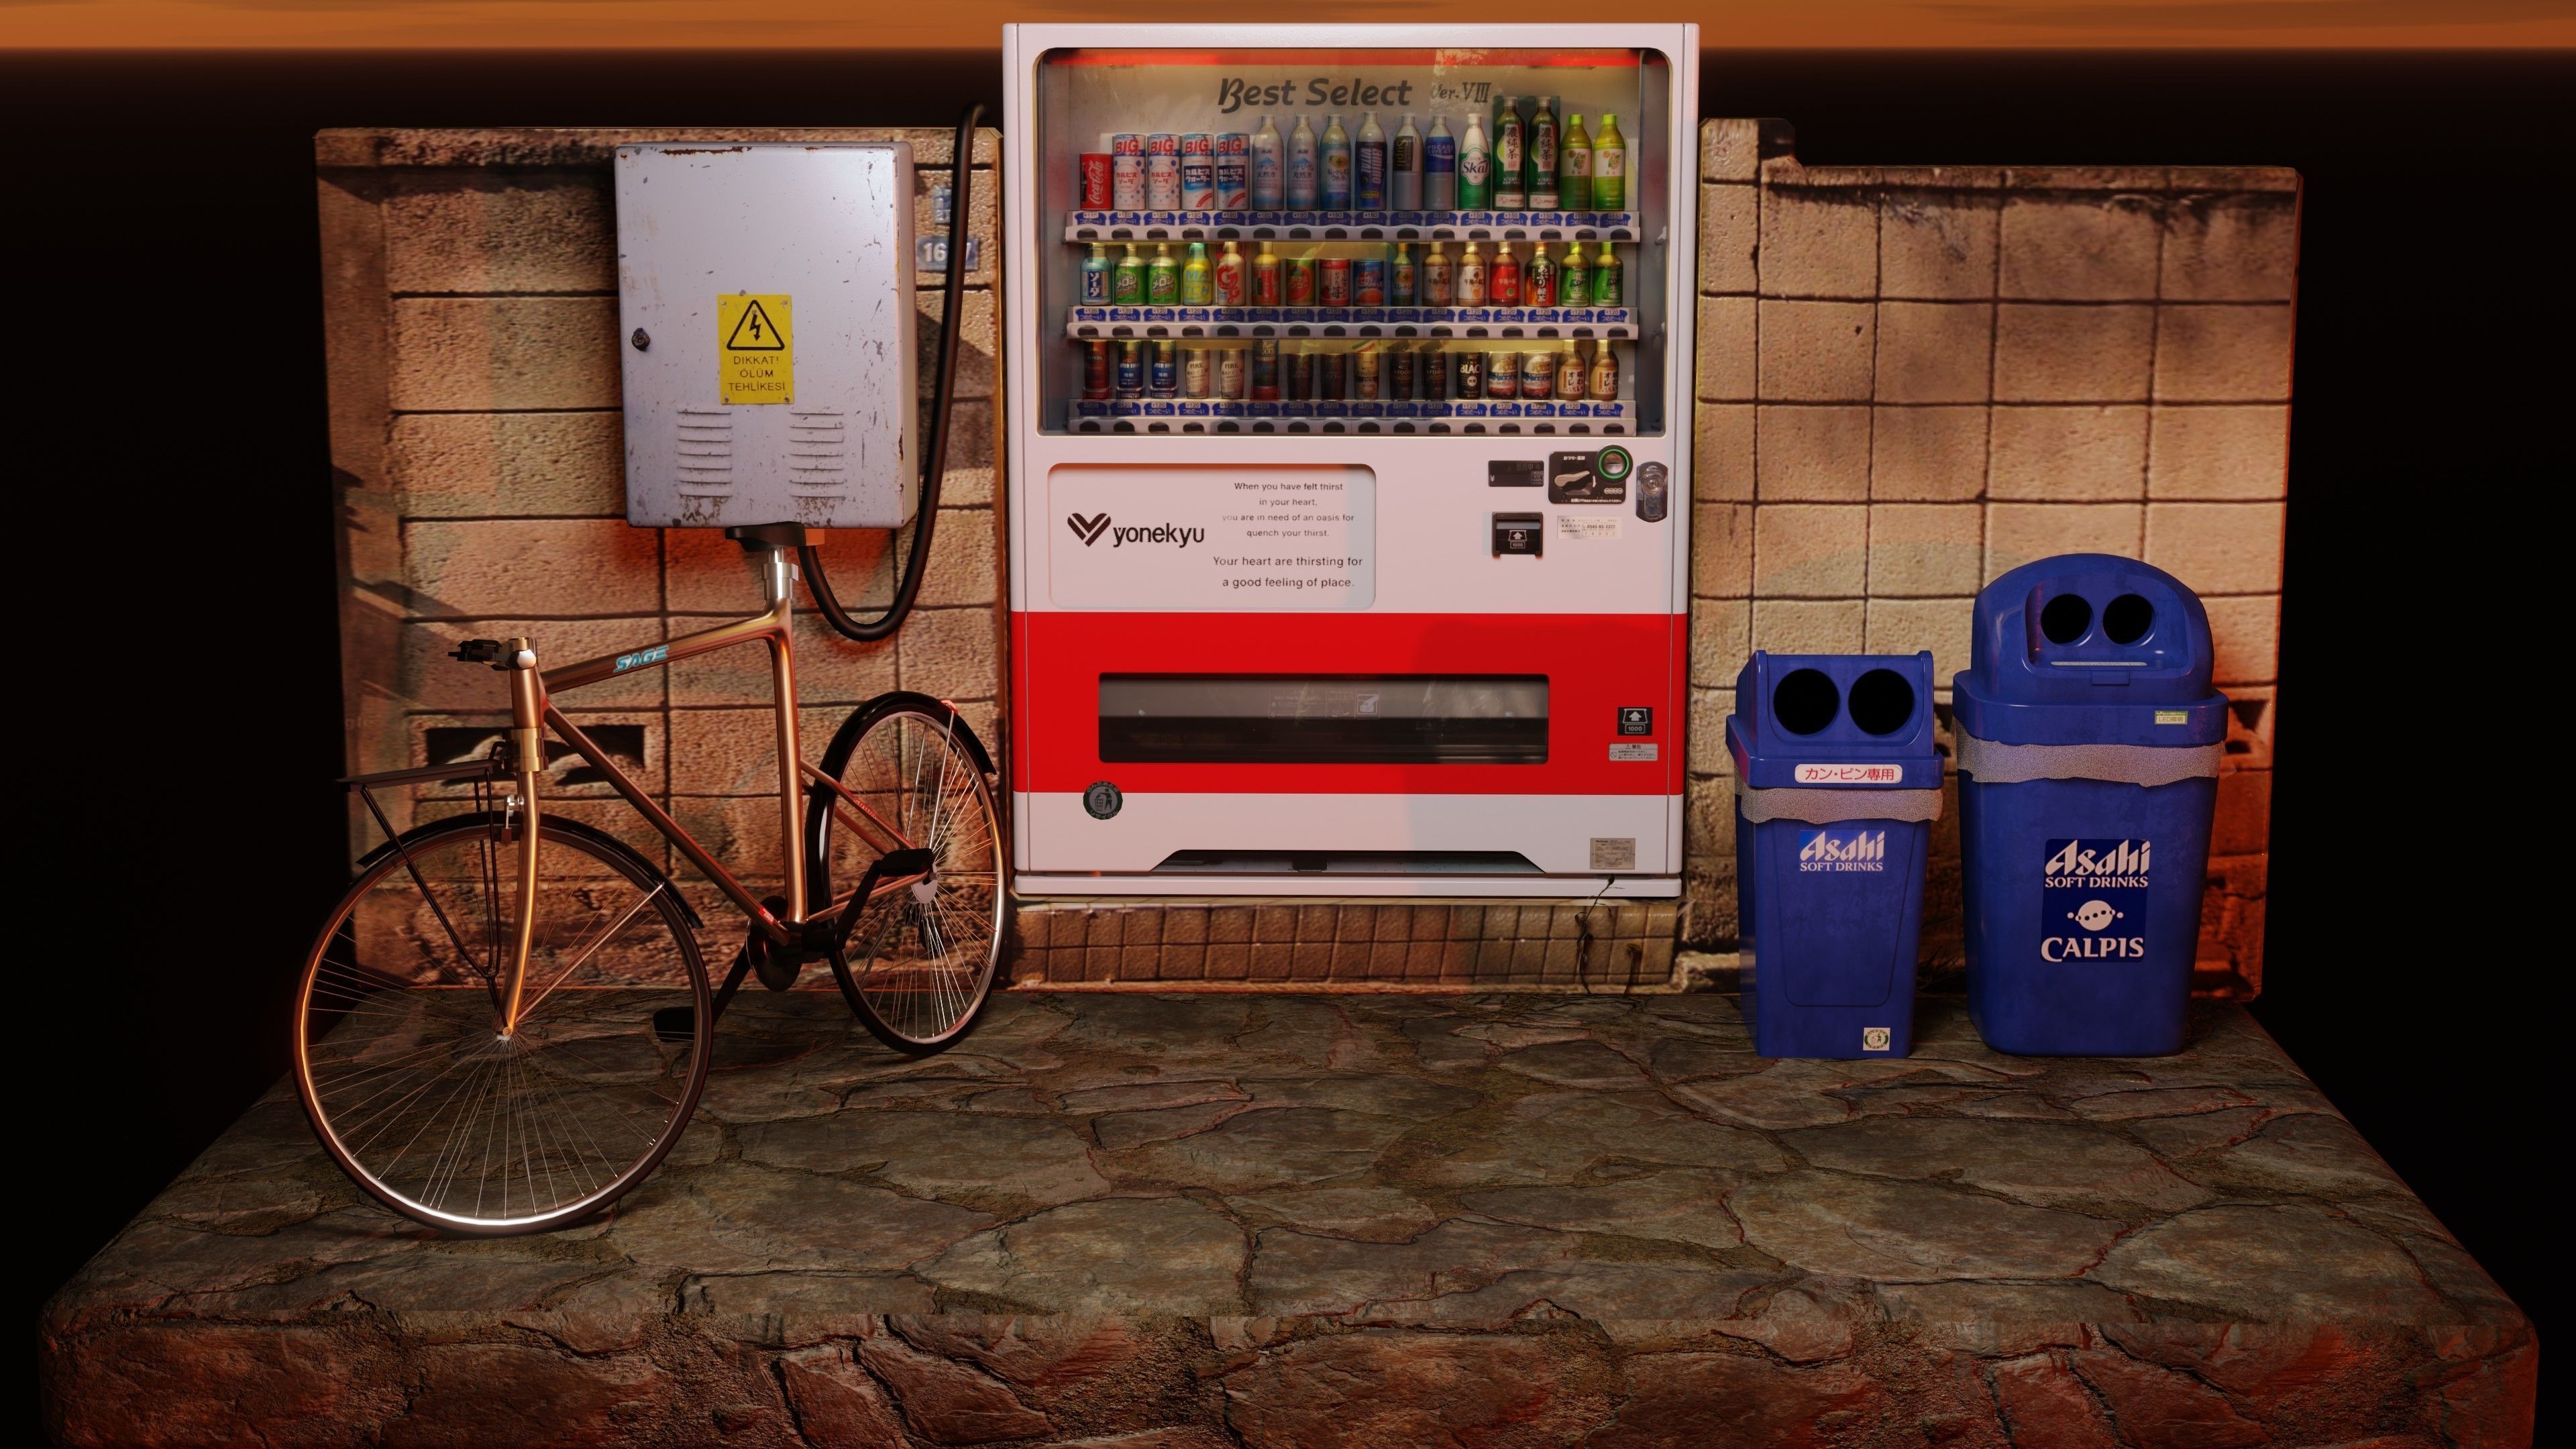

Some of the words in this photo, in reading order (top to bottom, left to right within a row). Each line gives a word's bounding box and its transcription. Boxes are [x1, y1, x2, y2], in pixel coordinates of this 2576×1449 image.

[1218, 78, 1297, 113] Best
[1305, 78, 1413, 106] Select
[1116, 139, 1138, 153] BIG
[1150, 139, 1174, 153] BIG
[1185, 138, 1208, 153] BIG
[1218, 138, 1242, 153] BIG
[1089, 272, 1099, 297] ソーダ
[1262, 484, 1278, 492] you
[1113, 523, 1205, 548] yonekyu
[1246, 529, 1279, 538] quench
[1214, 556, 1239, 566] Your
[1242, 556, 1272, 566] heart
[1296, 556, 1344, 568] thirsting
[1348, 556, 1363, 566] for
[1232, 578, 1262, 589] good
[1265, 578, 1303, 589] feeling
[1306, 578, 1318, 587] of
[1321, 578, 1354, 589] place.
[613, 645, 669, 673] SAGE
[1800, 831, 1885, 861] Asahi
[2045, 839, 2151, 876] Asahi
[1800, 862, 1833, 871] SOFT
[1835, 862, 1883, 871] DRINKS
[2045, 877, 2086, 888] SOFT
[2089, 876, 2149, 888] DRINKS
[2041, 937, 2144, 963] CALPIS
